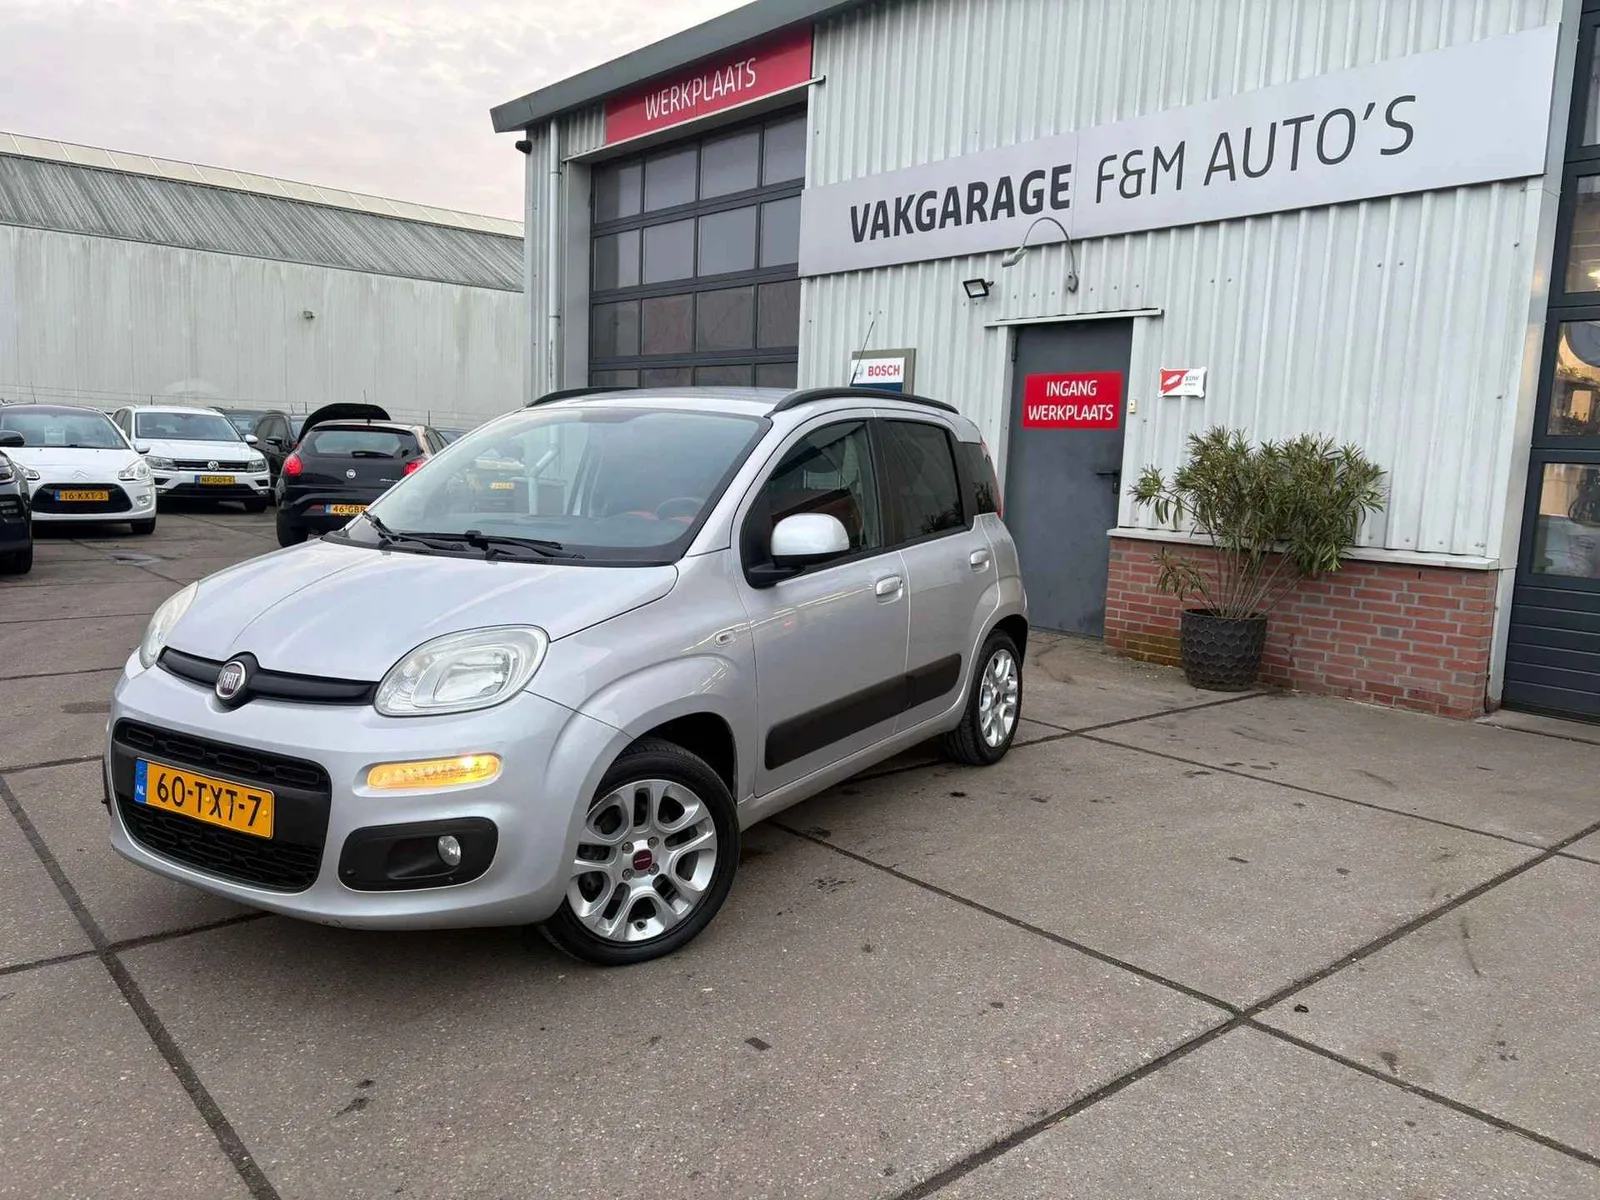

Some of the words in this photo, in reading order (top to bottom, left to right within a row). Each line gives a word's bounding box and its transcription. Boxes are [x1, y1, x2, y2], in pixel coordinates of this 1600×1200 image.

[644, 57, 757, 121] WERKPLAATS
[850, 164, 1072, 243] VAKGARAGE
[1096, 141, 1185, 203] F&M
[1203, 95, 1416, 186] AUTO'S
[867, 364, 901, 377] BOSCH
[1046, 380, 1097, 397] INGANG
[1028, 404, 1114, 421] WERKPLAATS
[136, 784, 146, 796] NL
[156, 773, 263, 827] 60-TXT-7
